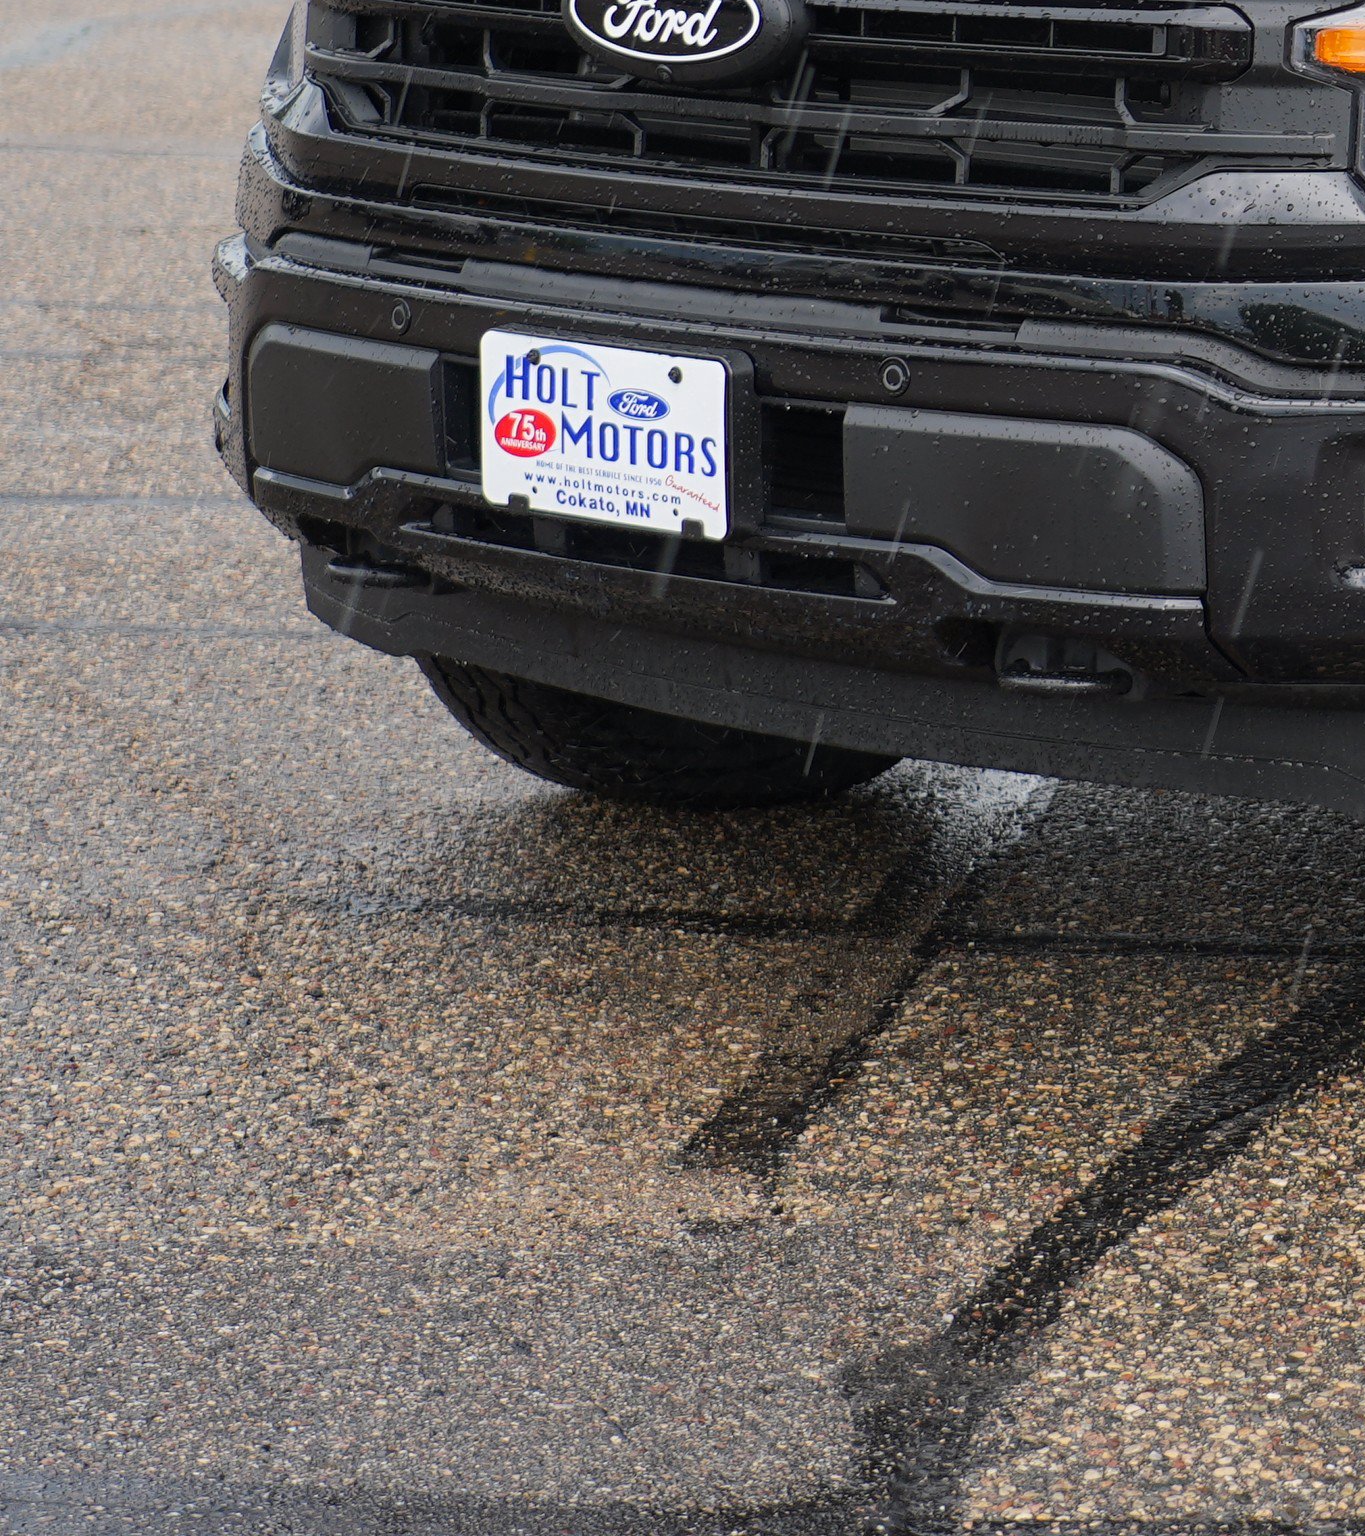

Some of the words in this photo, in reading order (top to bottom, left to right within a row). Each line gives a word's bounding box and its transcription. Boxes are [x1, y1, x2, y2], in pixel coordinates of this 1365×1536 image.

[506, 354, 600, 411] HOLT
[618, 391, 658, 417] Ford
[508, 413, 547, 441] 75th
[501, 437, 546, 452] ANNIVERSARY
[561, 410, 717, 477] MOTORS
[536, 460, 554, 469] HOME
[556, 462, 563, 470] OF
[565, 464, 576, 473] THE
[578, 466, 593, 475] BEST
[595, 469, 621, 480] SERVICE
[623, 473, 642, 483] SINCE
[645, 477, 662, 486] 1950
[524, 472, 681, 505] www.holtmotors.com
[665, 474, 720, 512] Guaranteed
[556, 489, 620, 517] Cokato,
[626, 500, 651, 519] MN
